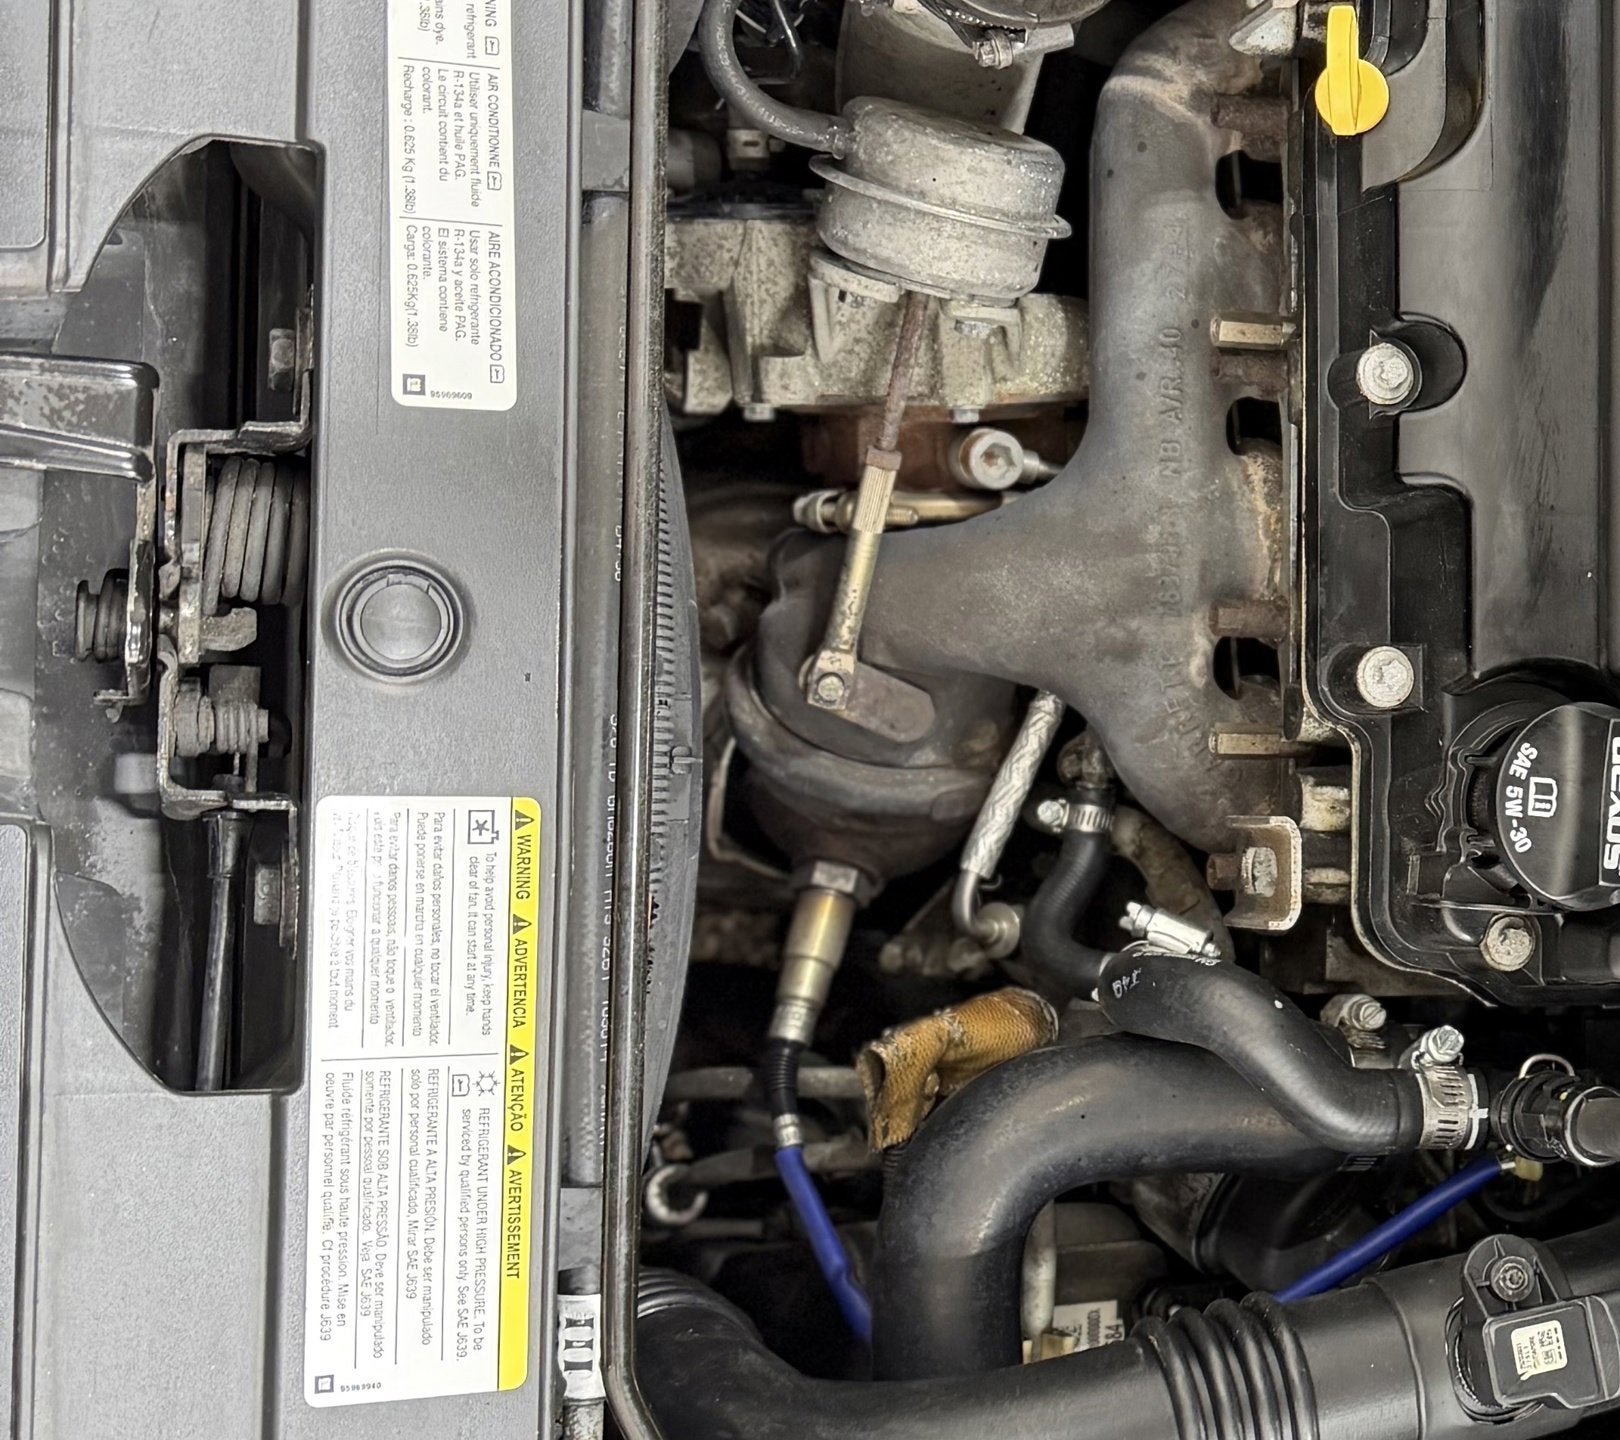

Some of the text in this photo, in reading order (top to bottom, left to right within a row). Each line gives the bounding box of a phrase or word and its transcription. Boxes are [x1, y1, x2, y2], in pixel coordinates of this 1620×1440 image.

[488, 261, 501, 361] ACONDICIONADO
[1504, 742, 1537, 853] SAE 5W-30
[506, 835, 531, 1278] WARNING ADVERTENCIA ATENÇÃO AVERTISSEMENT
